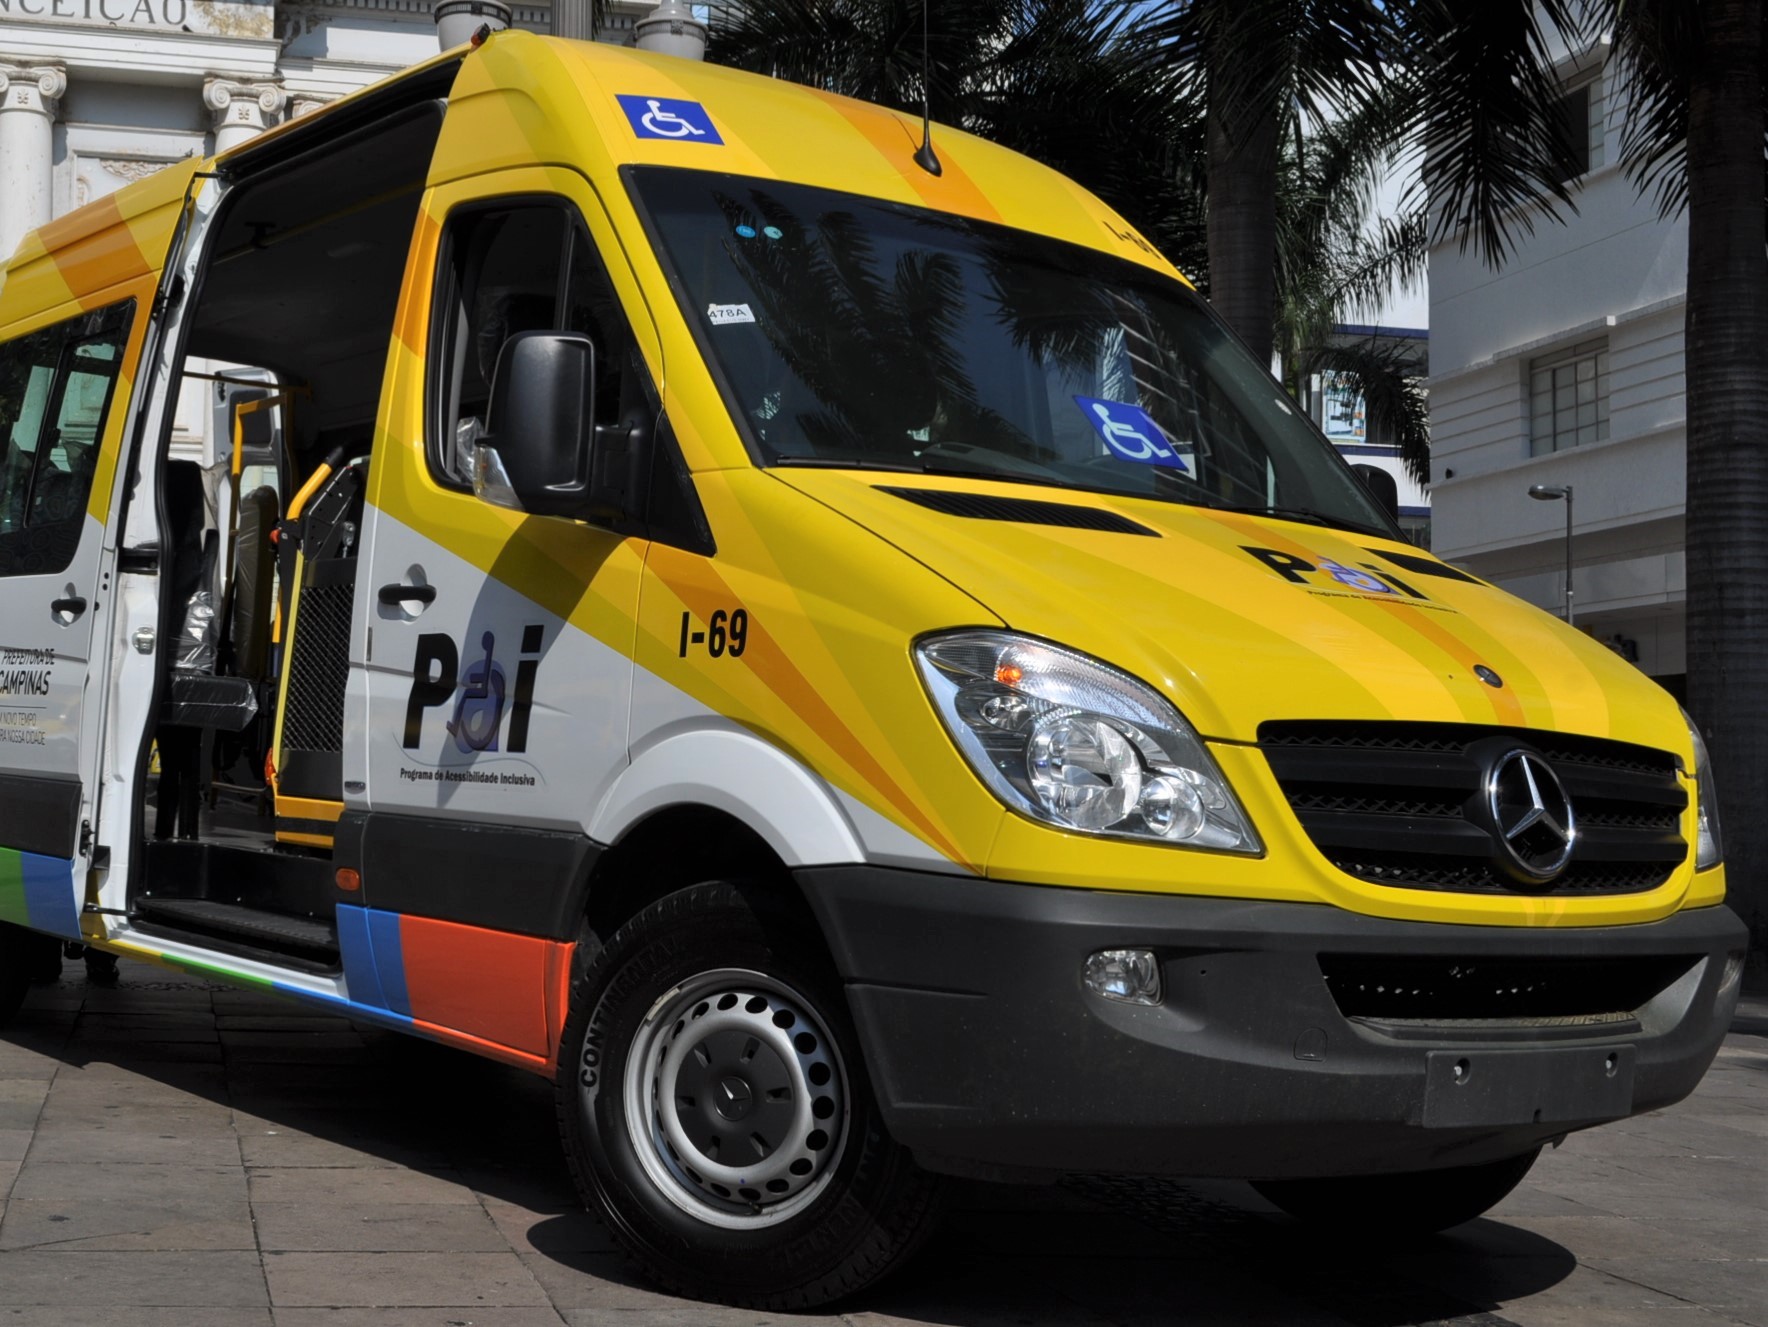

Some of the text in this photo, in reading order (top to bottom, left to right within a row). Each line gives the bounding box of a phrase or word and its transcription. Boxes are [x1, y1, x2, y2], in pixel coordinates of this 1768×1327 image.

[679, 608, 748, 658] I-69
[2, 648, 55, 665] PREFEITURA DE
[403, 624, 545, 754] Pai
[400, 768, 536, 786] Programa de Acessibilidade Inclusiva
